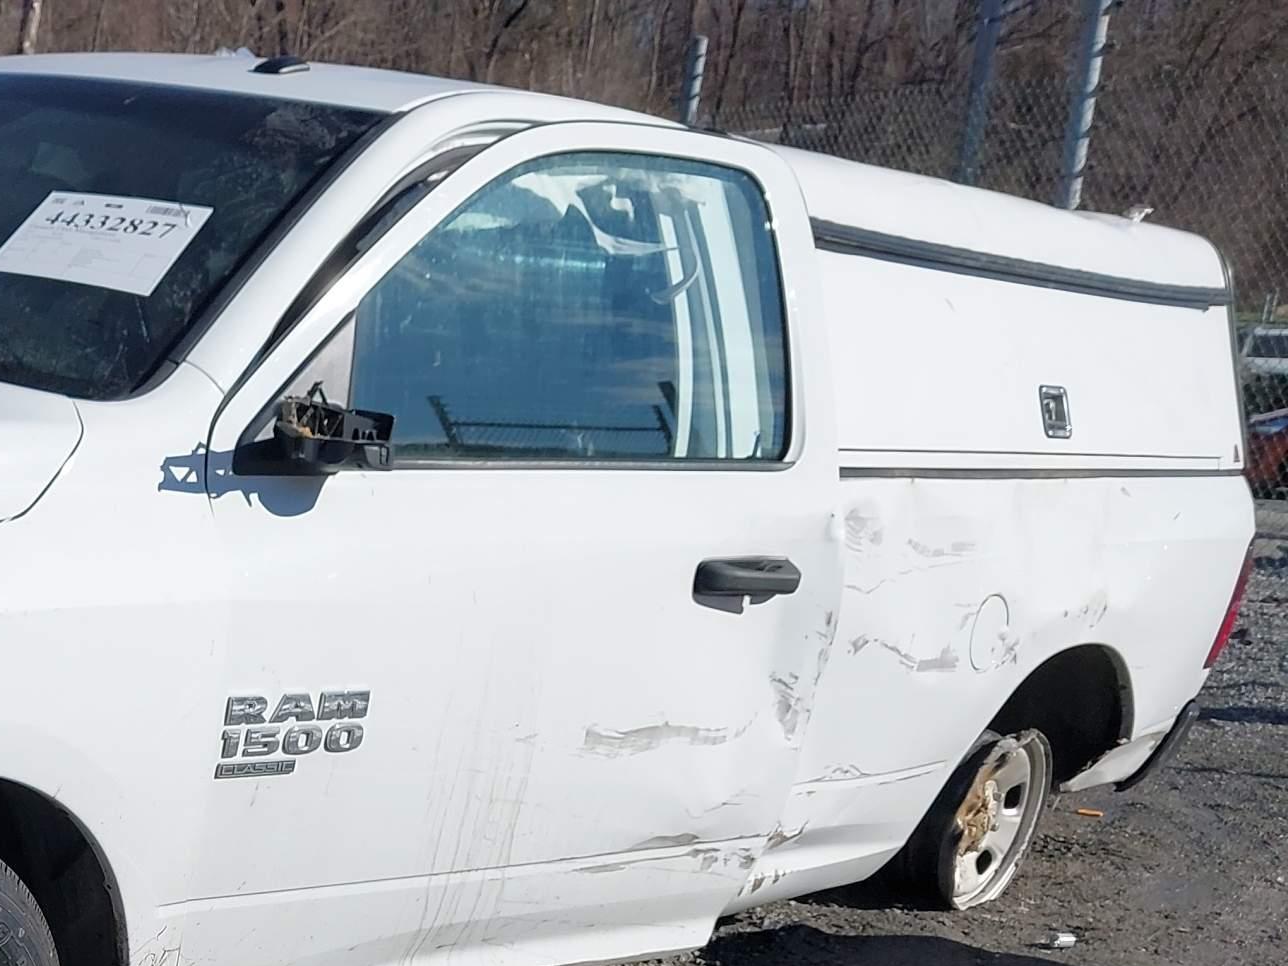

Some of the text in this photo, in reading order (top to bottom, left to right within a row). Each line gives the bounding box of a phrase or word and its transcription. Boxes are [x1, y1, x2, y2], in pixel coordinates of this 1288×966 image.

[45, 211, 177, 239] 44332827
[224, 690, 371, 726] RAM
[221, 724, 364, 759] 1500
[214, 759, 297, 779] CLASSIC
